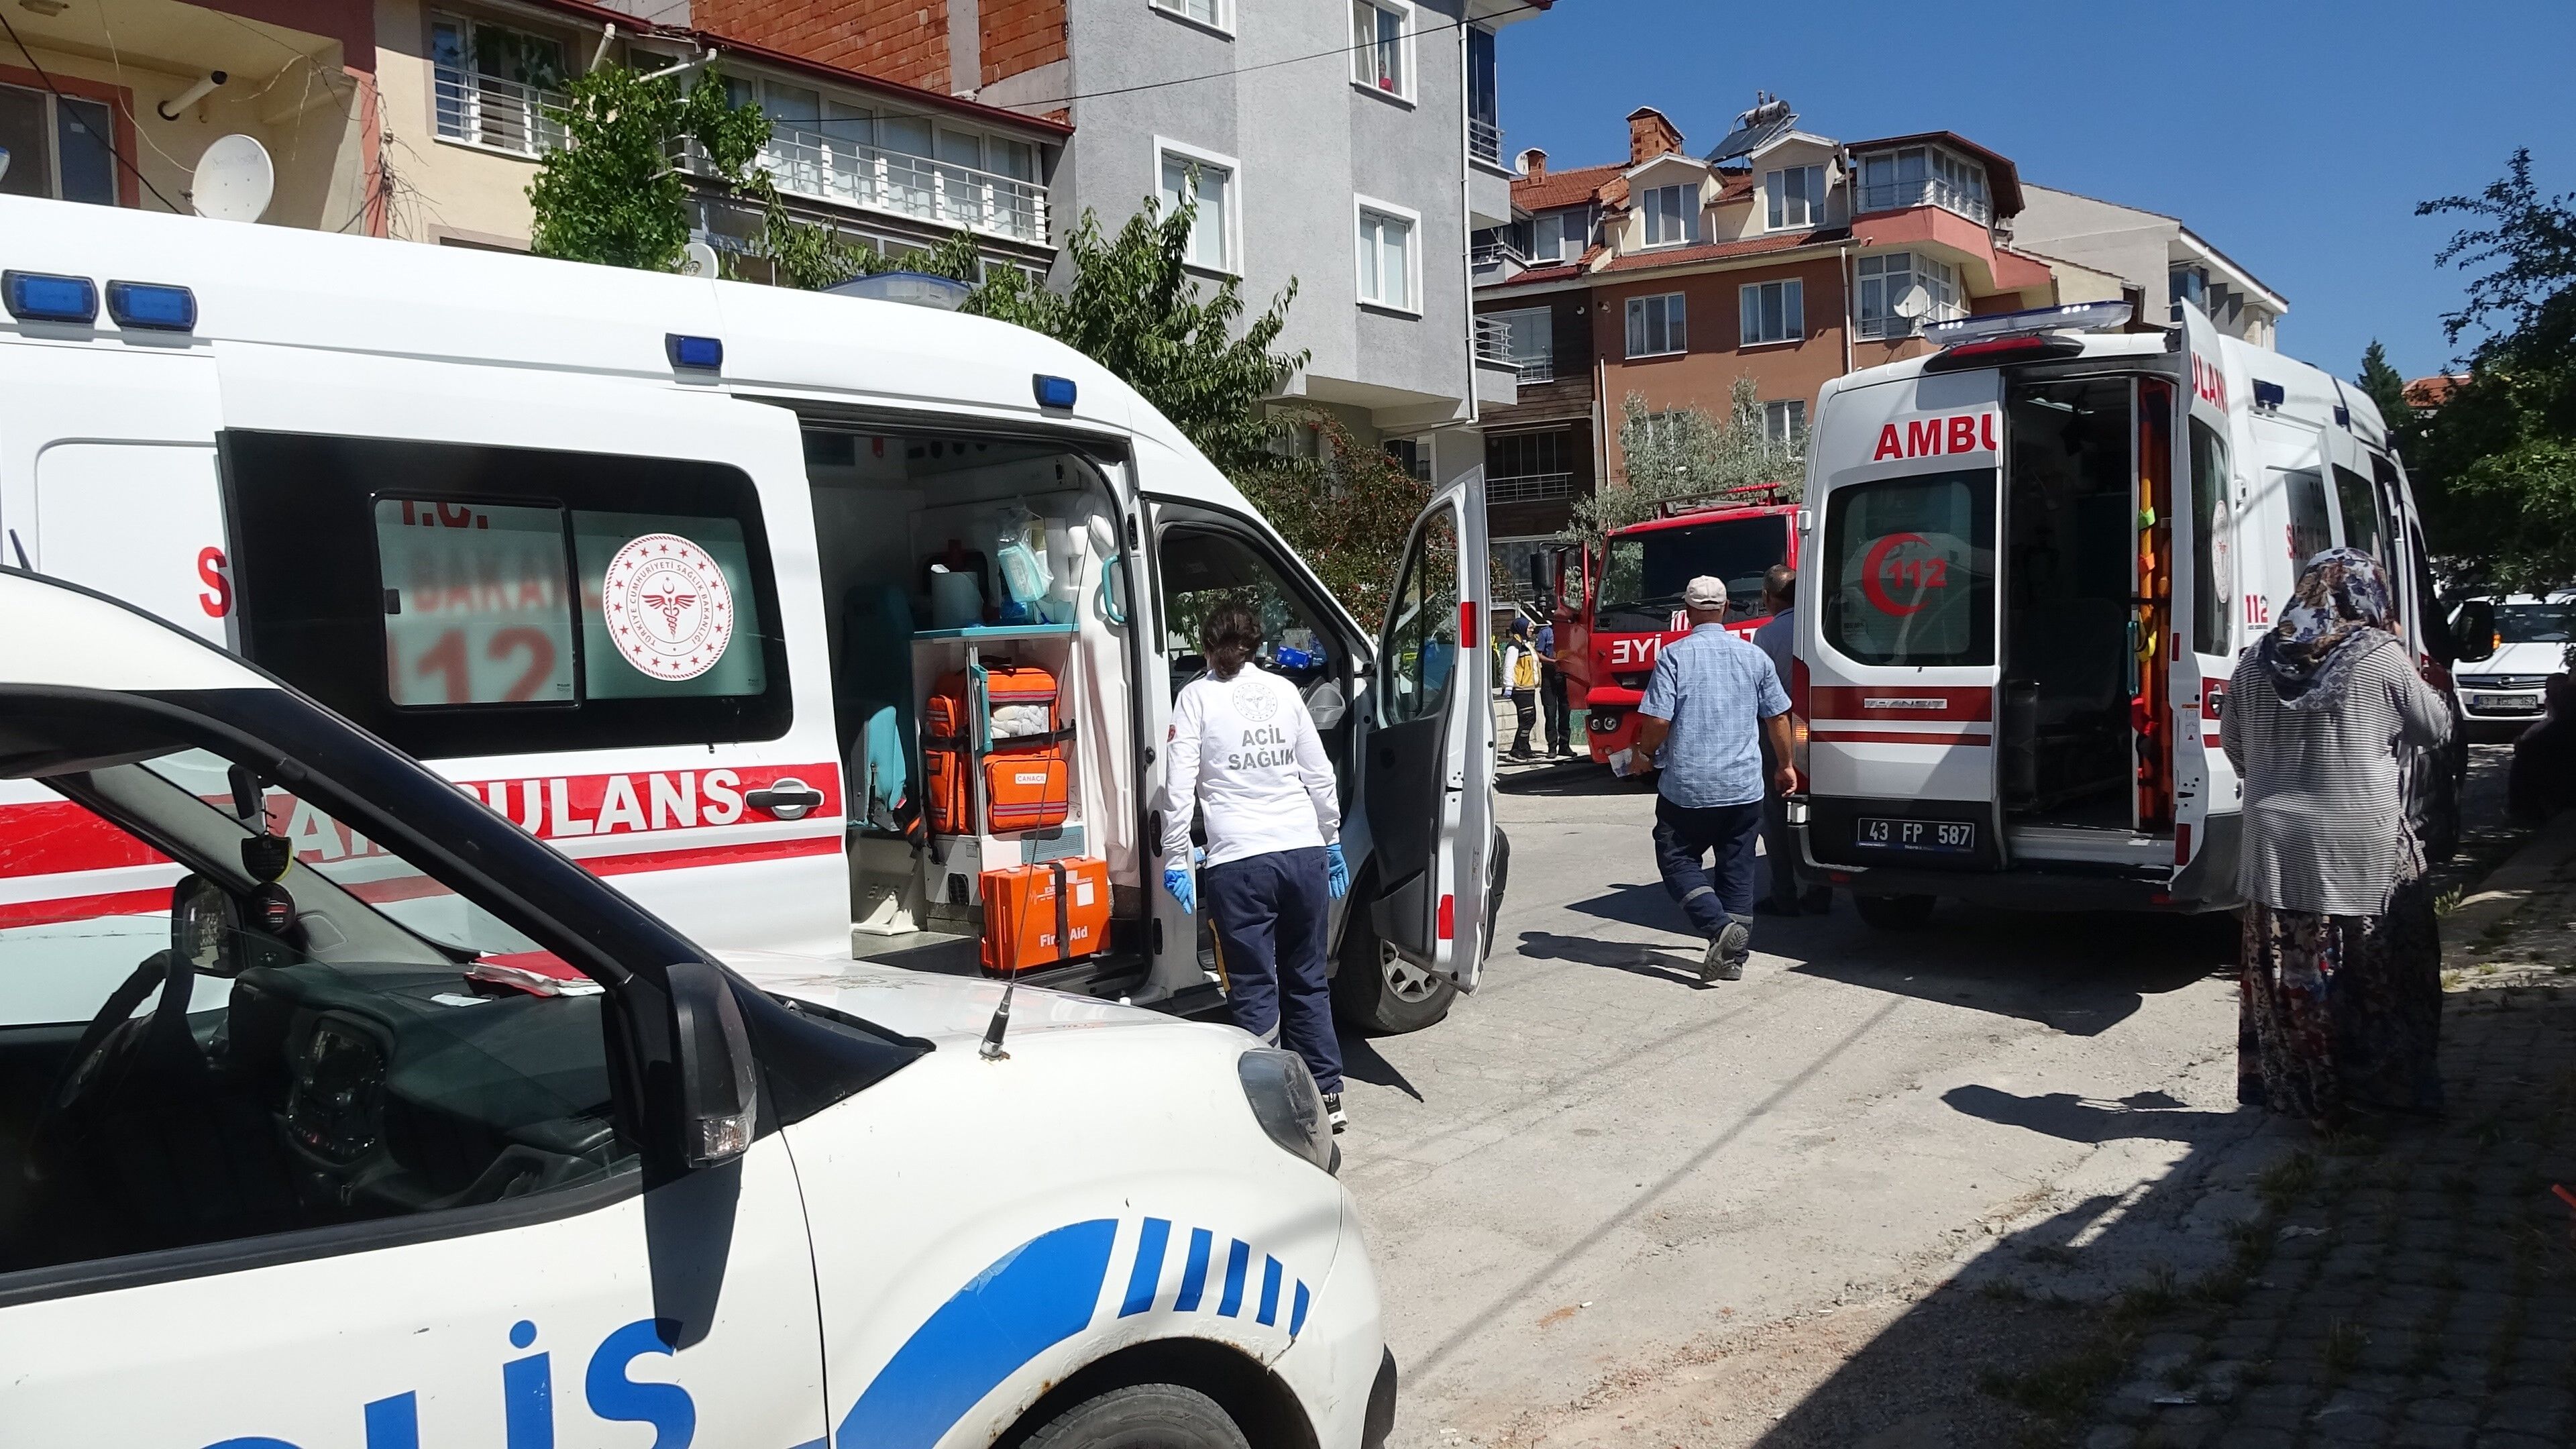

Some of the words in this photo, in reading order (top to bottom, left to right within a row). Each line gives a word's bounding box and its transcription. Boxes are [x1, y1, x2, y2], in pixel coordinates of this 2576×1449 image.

[630, 561, 674, 604] CUMHURİYETİ
[677, 564, 704, 591] SAĞLIK
[1887, 557, 1947, 589] 112
[692, 594, 710, 645] BAKANLIĞI
[2245, 594, 2268, 624] 112
[631, 608, 655, 646] TÜRKİYE
[1242, 724, 1286, 747] ACİL
[1228, 747, 1295, 770] SAĞLIK
[1869, 821, 1888, 841] 43
[1902, 822, 1923, 843] FP
[1938, 824, 1970, 845] 587
[1070, 925, 1088, 941] Aid
